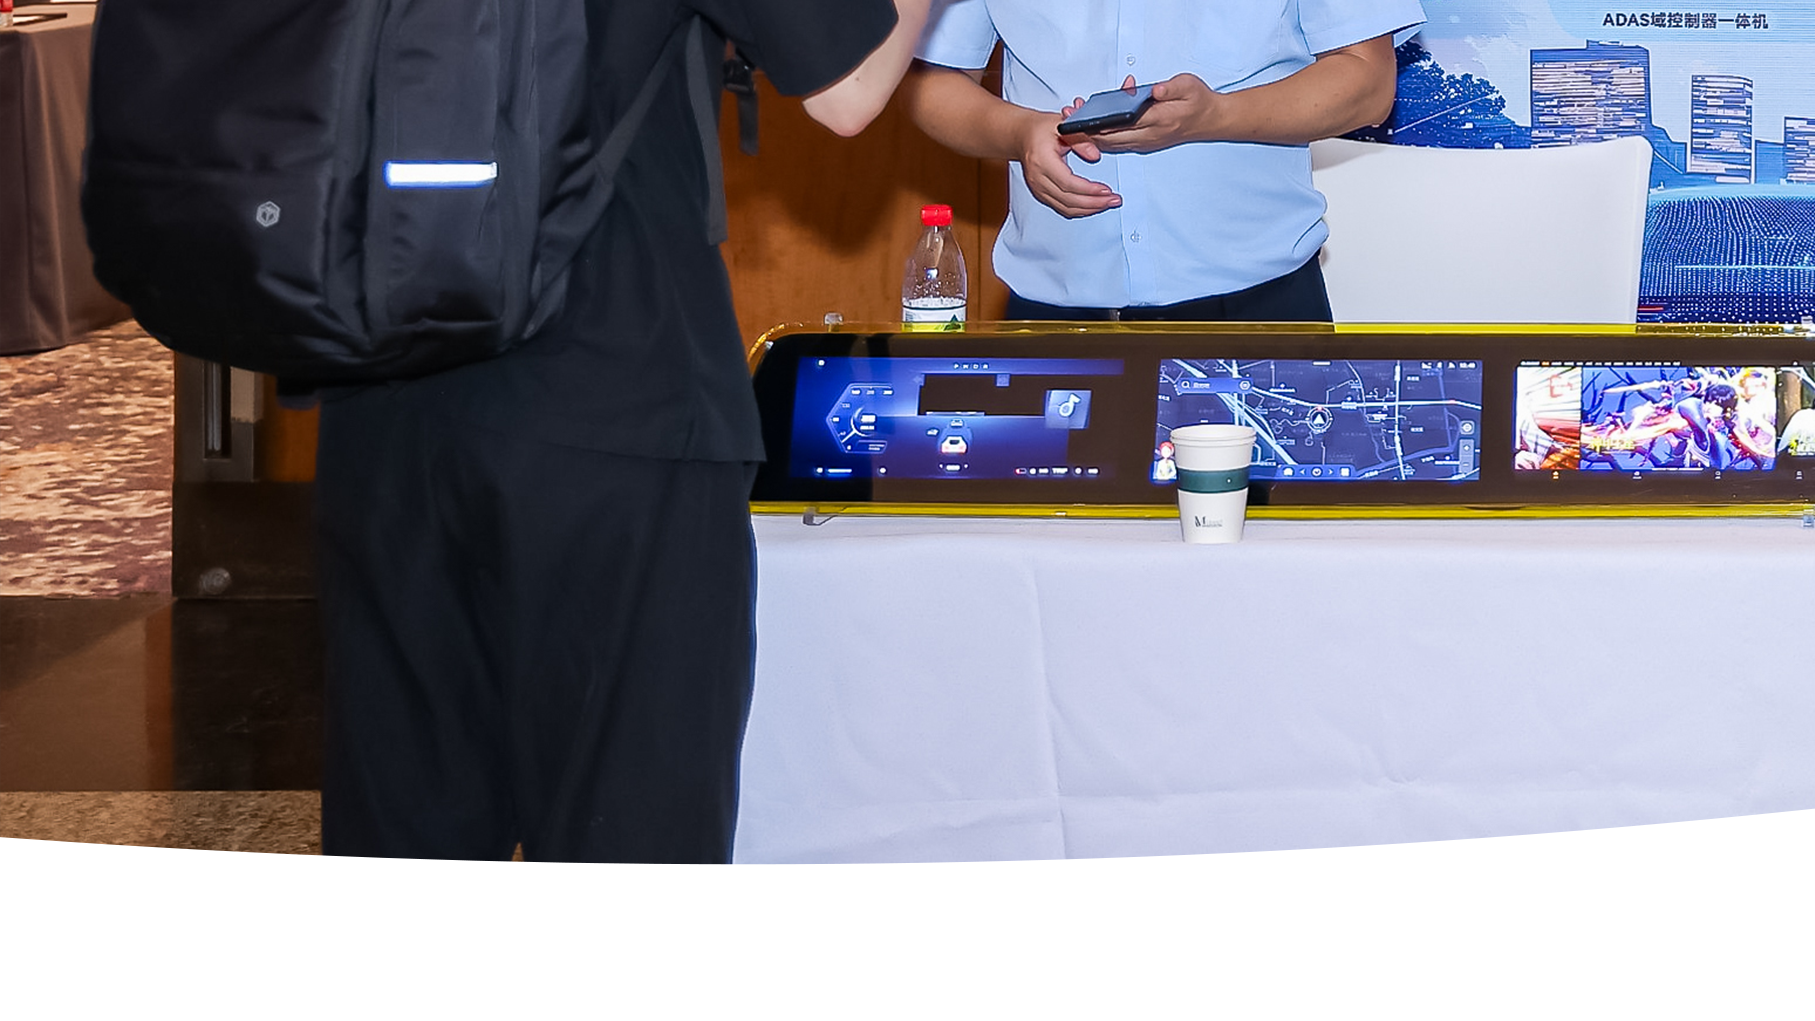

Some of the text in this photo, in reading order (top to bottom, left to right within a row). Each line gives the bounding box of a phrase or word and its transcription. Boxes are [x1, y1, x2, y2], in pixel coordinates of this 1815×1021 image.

[1603, 12, 1769, 30] ADAS域控制器一体机
